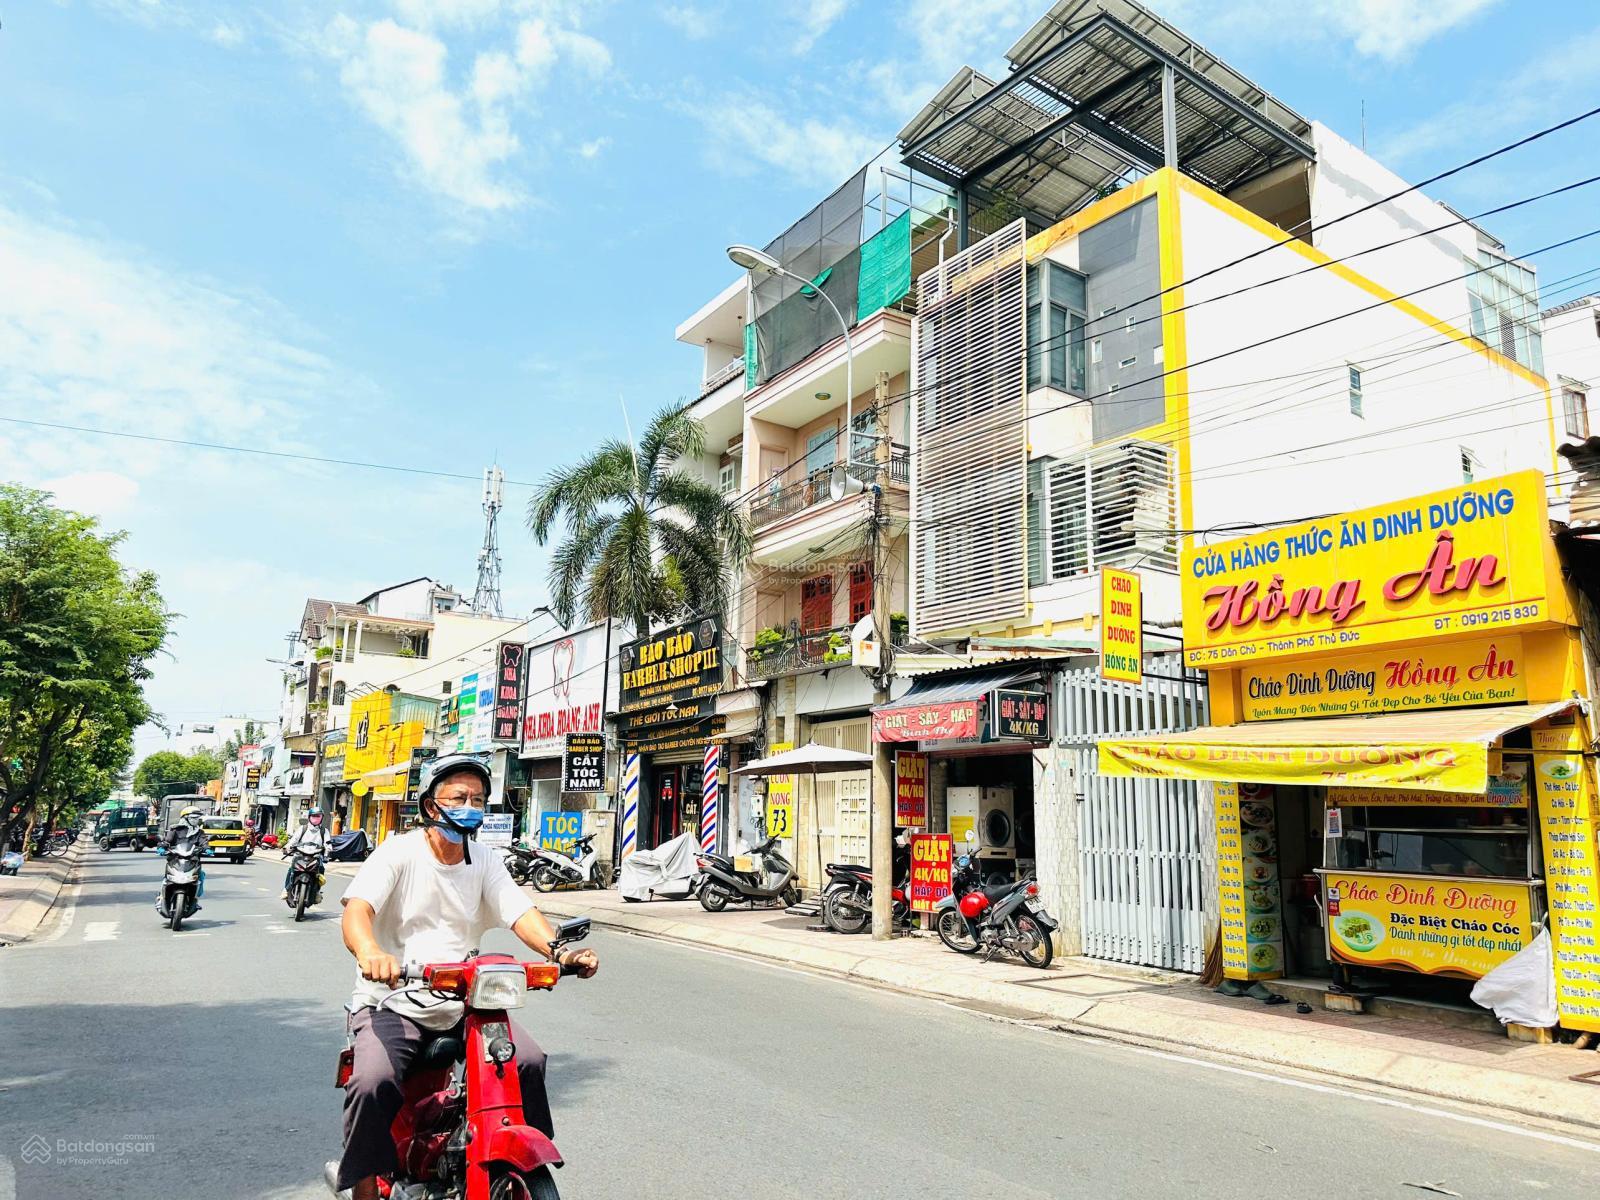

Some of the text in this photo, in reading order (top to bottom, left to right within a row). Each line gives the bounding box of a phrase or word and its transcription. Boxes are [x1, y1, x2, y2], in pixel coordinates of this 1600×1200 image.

[1193, 489, 1514, 578] CỬA HÀNG THỨC ĂN DINH DƯỠNG
[1203, 530, 1506, 630] Hồng Ân
[1111, 600, 1132, 617] DINH
[1461, 612, 1489, 626] 0919
[1491, 608, 1511, 622] 215
[1513, 604, 1538, 619] 830
[1297, 634, 1315, 648] Phố
[1339, 631, 1360, 643] Đức
[623, 662, 667, 690] BARBER
[669, 651, 703, 679] SHOP
[1383, 643, 1518, 690] Hồng Ân
[1249, 667, 1376, 700] Cháo Dinh Dưỡng
[1402, 695, 1421, 706] Cho
[679, 705, 699, 718] NAM
[1009, 720, 1039, 735] 4K/KG
[572, 766, 599, 778] TÓC
[569, 779, 600, 788] NAM
[772, 809, 787, 832] 73
[913, 834, 950, 867] GIẶT
[914, 867, 949, 883] 4K/KG
[1335, 880, 1379, 901] Cháo
[1390, 913, 1520, 935] Đặc Biệt Cháo Cóc
